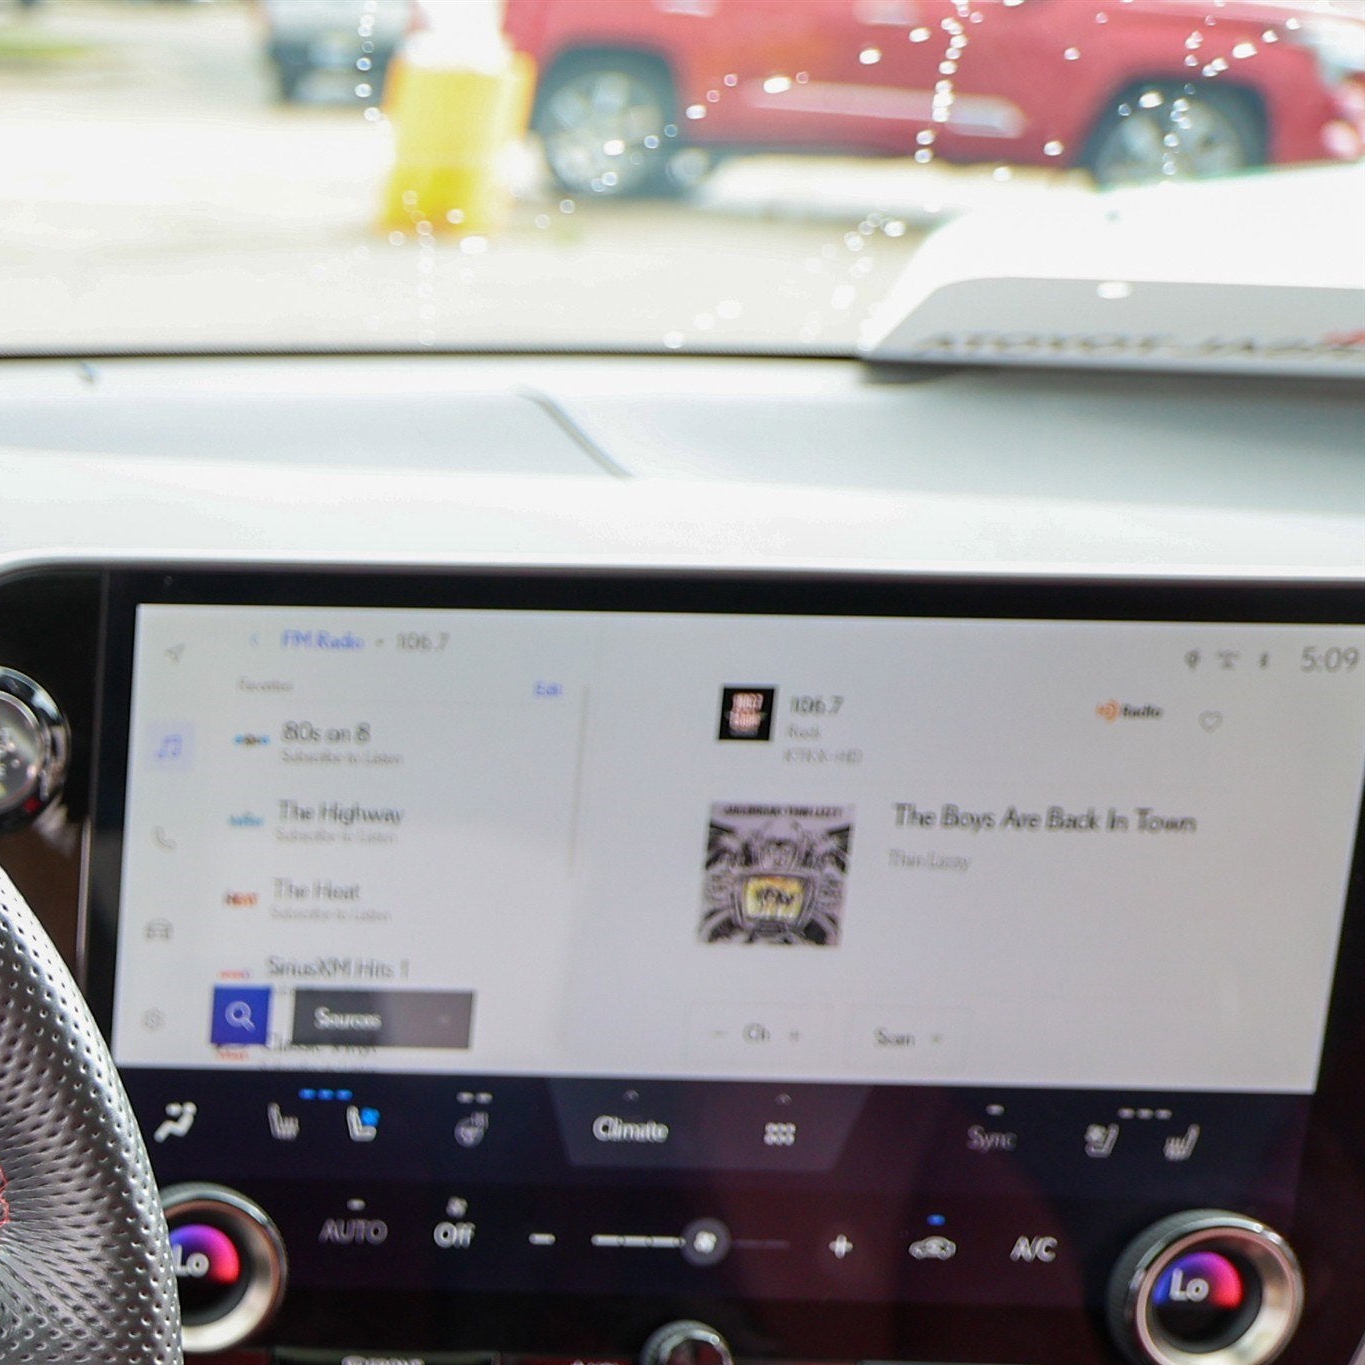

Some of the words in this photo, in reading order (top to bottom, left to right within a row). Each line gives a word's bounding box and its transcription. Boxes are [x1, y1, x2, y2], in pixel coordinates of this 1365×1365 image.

[316, 631, 366, 651] Radio
[396, 632, 450, 652] 106.7
[1300, 648, 1360, 674] 5:09
[534, 682, 562, 697] Edit
[790, 696, 844, 715] 106.7
[281, 720, 321, 744] 80s
[325, 728, 351, 742] on
[356, 722, 371, 744] 8
[279, 799, 313, 820] The
[320, 801, 404, 825] Highway
[893, 802, 936, 830] The
[941, 804, 996, 834] Boys
[1005, 807, 1040, 833] Are
[1045, 807, 1099, 833] Back
[1107, 808, 1129, 832] In
[1135, 808, 1197, 834] Town
[273, 877, 310, 898] The
[313, 880, 360, 900] Heat
[269, 957, 352, 977] SiriusXM
[314, 1007, 381, 1031] Sources
[874, 1028, 915, 1048] Scan
[592, 1115, 668, 1144] Climate
[967, 1125, 1017, 1152] Sync
[319, 1219, 388, 1244] AUTO
[434, 1221, 475, 1249] Off
[170, 1244, 210, 1278] Lo
[1009, 1236, 1058, 1263] A/C
[1170, 1269, 1209, 1302] Lo
